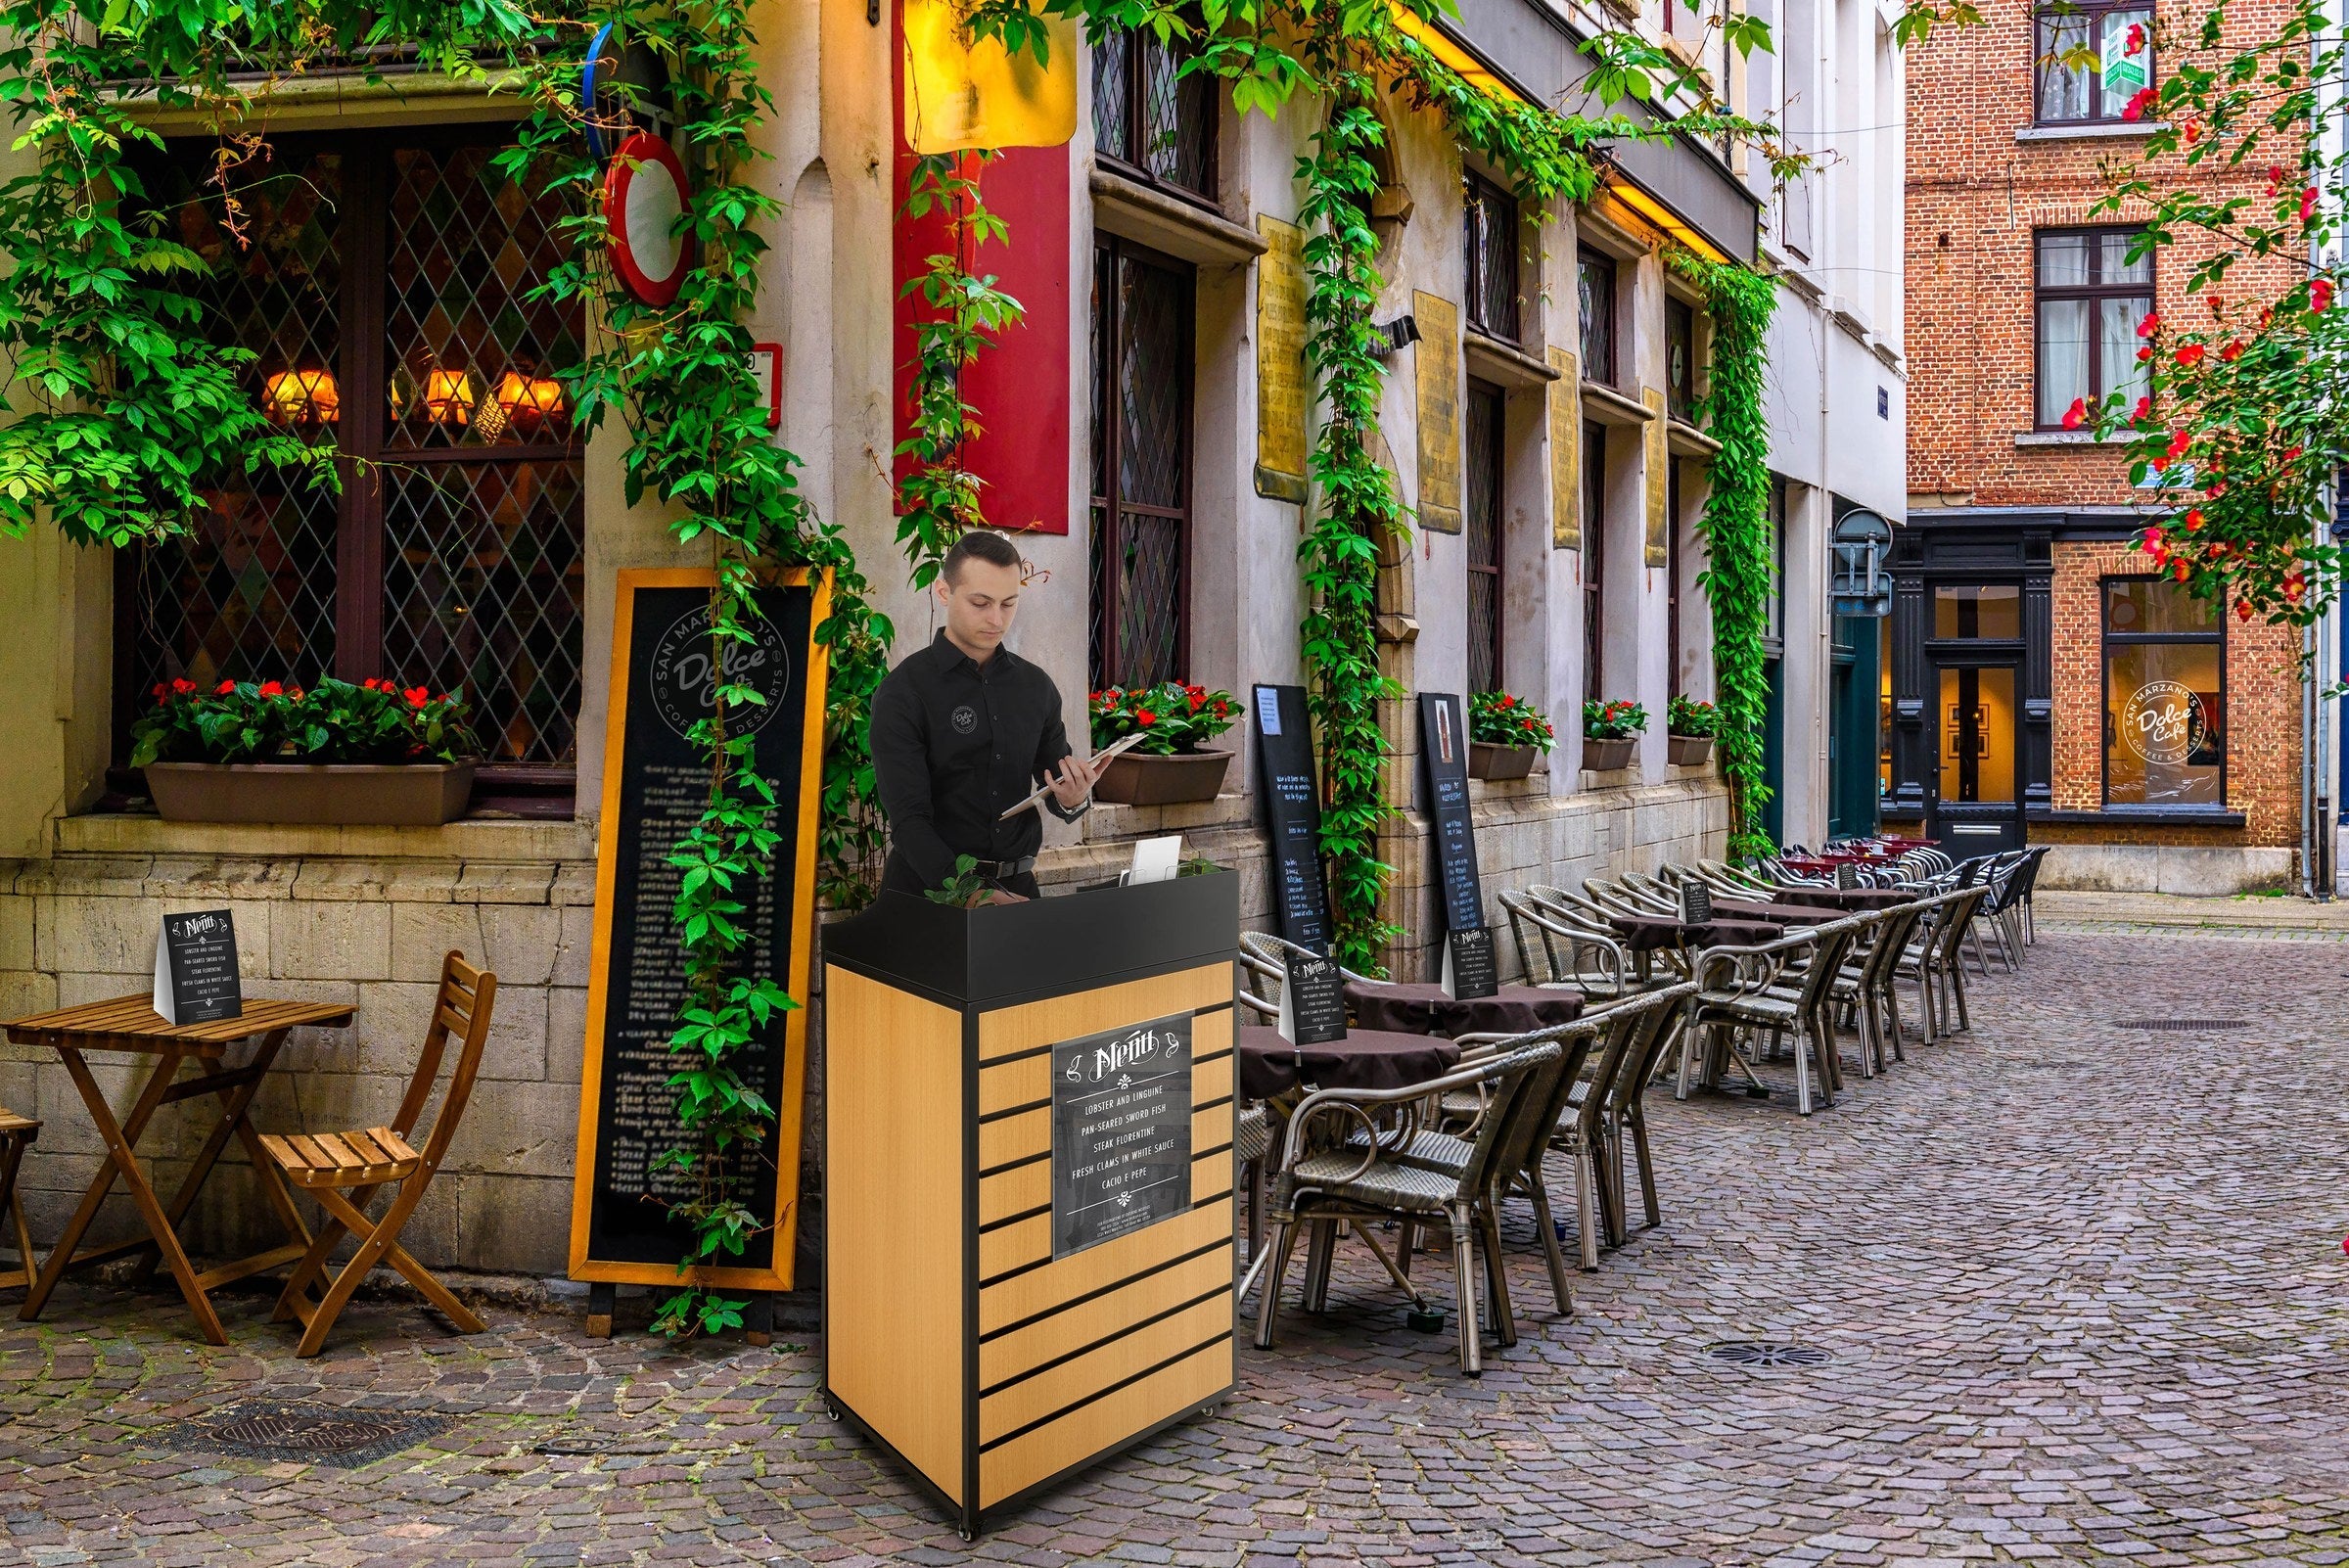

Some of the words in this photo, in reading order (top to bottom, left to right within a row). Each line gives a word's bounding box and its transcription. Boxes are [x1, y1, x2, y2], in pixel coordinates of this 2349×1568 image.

[657, 643, 675, 681] SAN
[674, 609, 776, 647] MAR'S
[673, 642, 766, 690] Dolce
[736, 669, 783, 734] DESSERTS
[2127, 704, 2138, 726] SAN
[2136, 684, 2198, 707] MARZANO'S
[2137, 704, 2192, 732] Dolce
[2133, 739, 2162, 761] COFFEE
[2176, 720, 2202, 759] DESSERTS
[1082, 1117, 1123, 1136] PAN-SEARED
[1126, 1109, 1149, 1124] SWORD
[1152, 1104, 1167, 1116] FISH
[1084, 1099, 1114, 1116] LOBSTER
[1117, 1095, 1130, 1106] AND
[1133, 1085, 1163, 1101] LINGUINE
[1072, 1165, 1094, 1179] FRESH
[1096, 1157, 1120, 1172] CLAMS
[1122, 1154, 1129, 1164] IN
[1131, 1146, 1152, 1160] WHITE
[1155, 1139, 1174, 1153] SAUCE
[1093, 1139, 1114, 1153] STEAK
[1117, 1127, 1155, 1145] FLORENTINE
[1102, 1176, 1122, 1189] CACIO
[1131, 1167, 1147, 1179] PEPE
